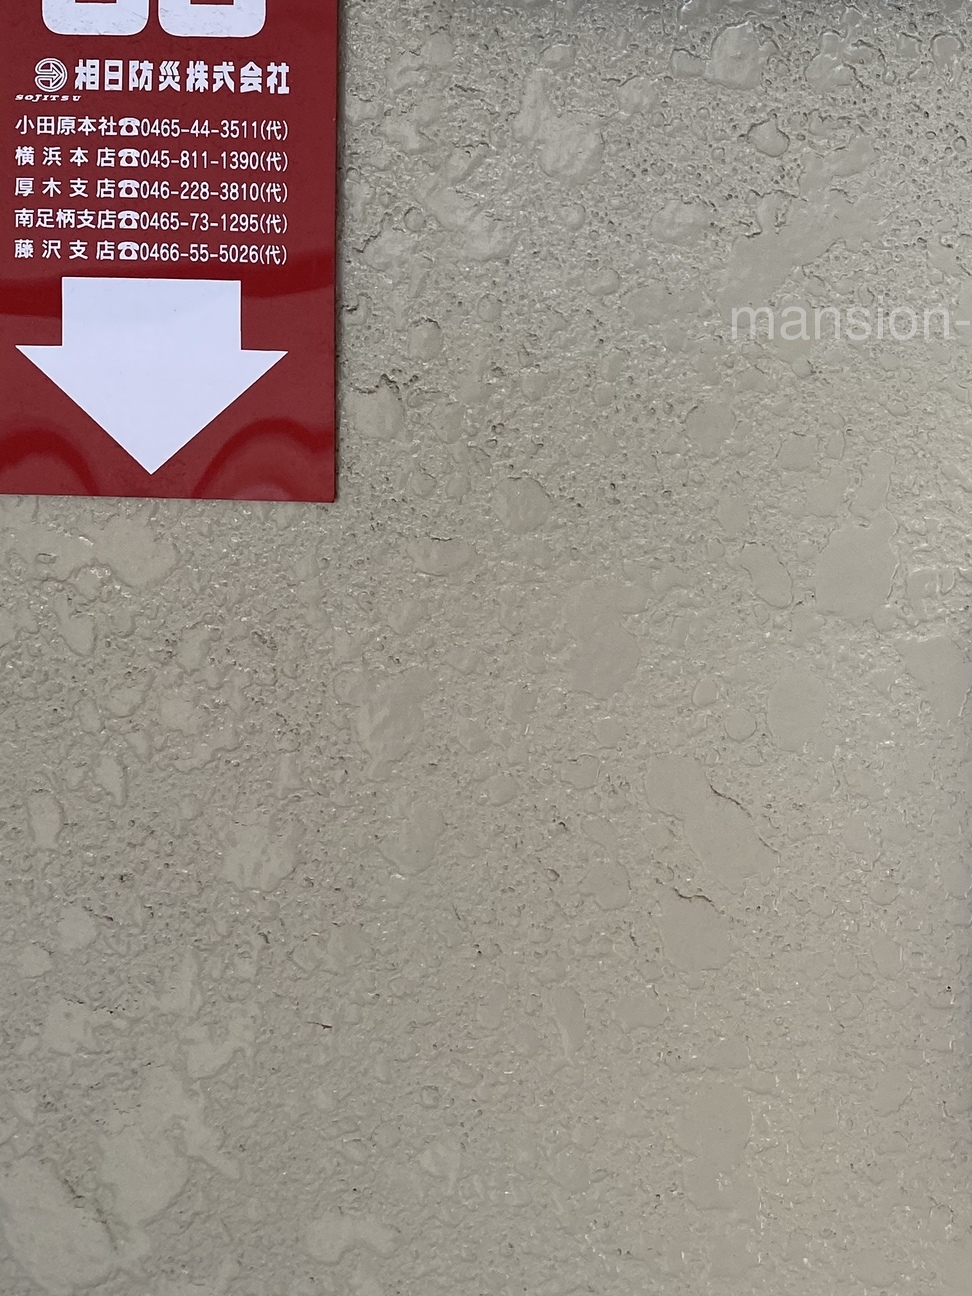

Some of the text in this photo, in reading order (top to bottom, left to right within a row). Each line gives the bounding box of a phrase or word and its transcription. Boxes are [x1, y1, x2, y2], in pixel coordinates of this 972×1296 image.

[74, 59, 290, 94] 相日防災株式会社
